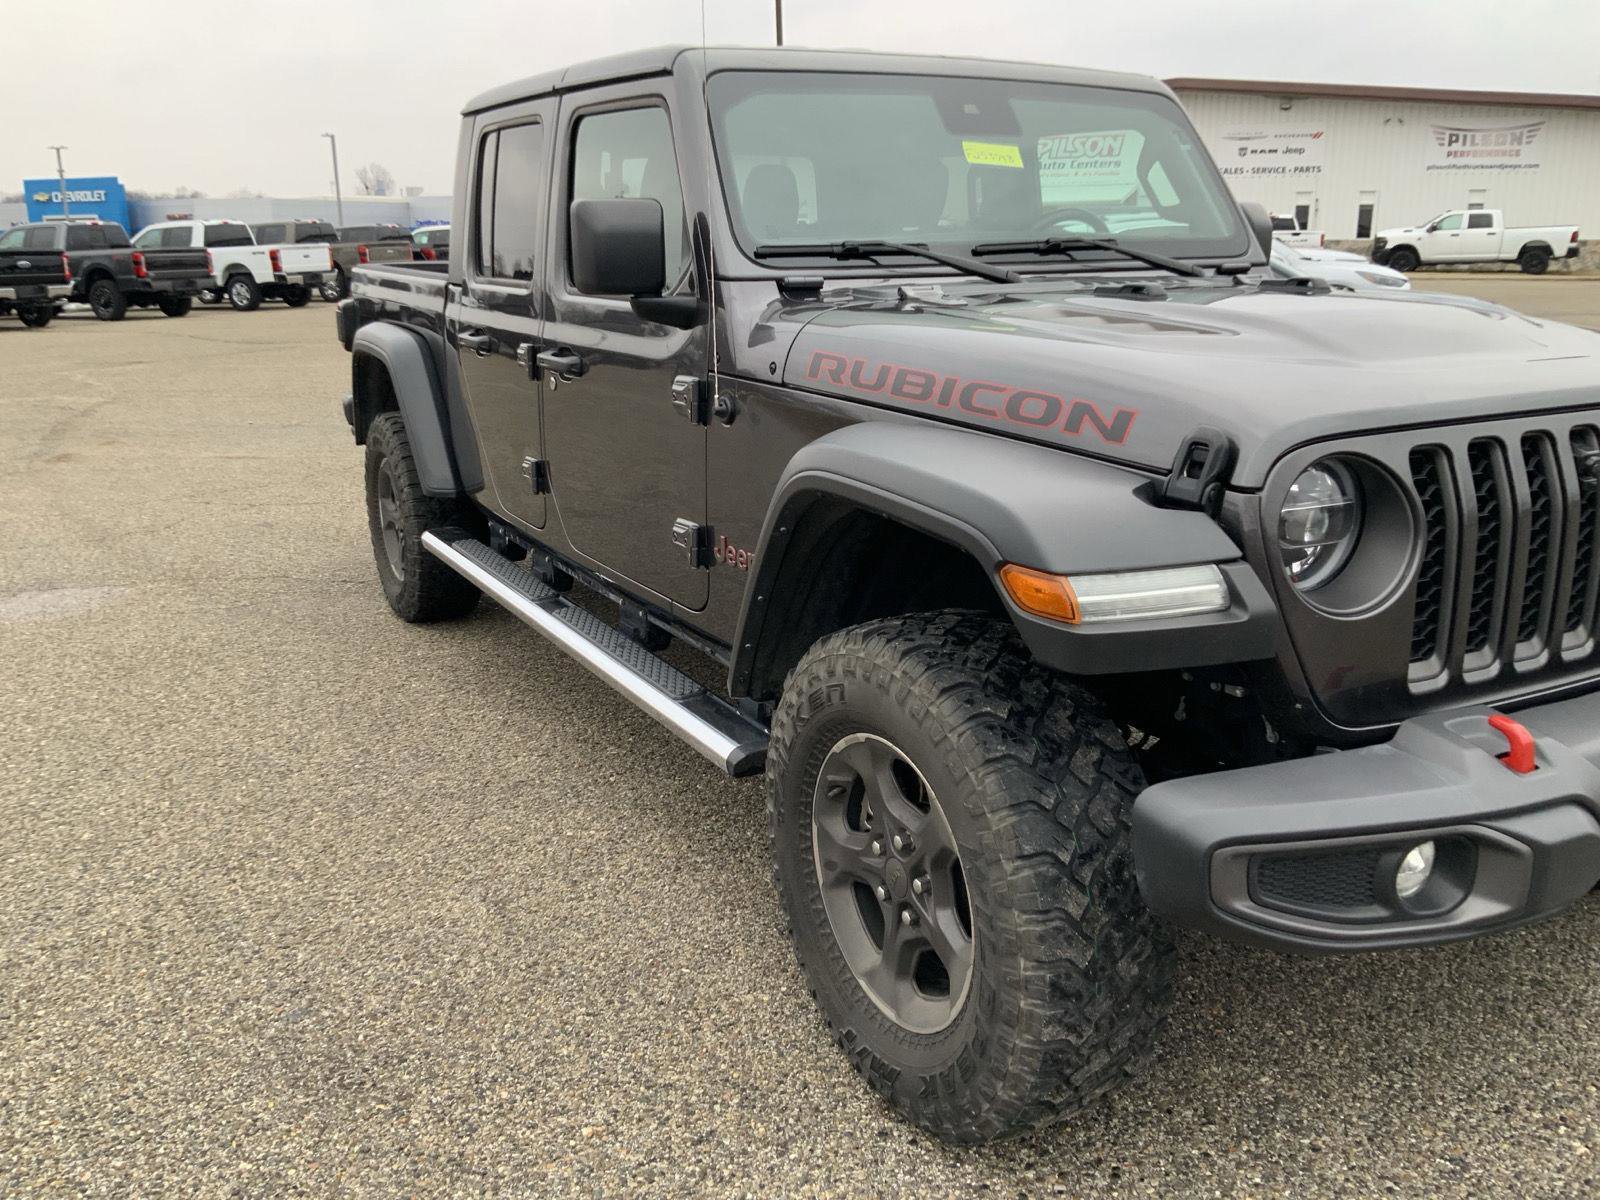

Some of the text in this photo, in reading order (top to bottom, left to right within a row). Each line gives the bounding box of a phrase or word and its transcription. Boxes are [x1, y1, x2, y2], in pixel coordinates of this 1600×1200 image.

[1447, 131, 1524, 147] PILSON
[1037, 135, 1125, 160] PILSON
[1282, 146, 1306, 156] Jeep
[1446, 148, 1522, 158] PERFORMANCE
[1069, 159, 1121, 169] Centers
[1250, 166, 1286, 175] SERVICE
[1293, 165, 1322, 174] PARTS
[51, 190, 107, 203] CHEVROLET
[803, 350, 1140, 445] RUBICON
